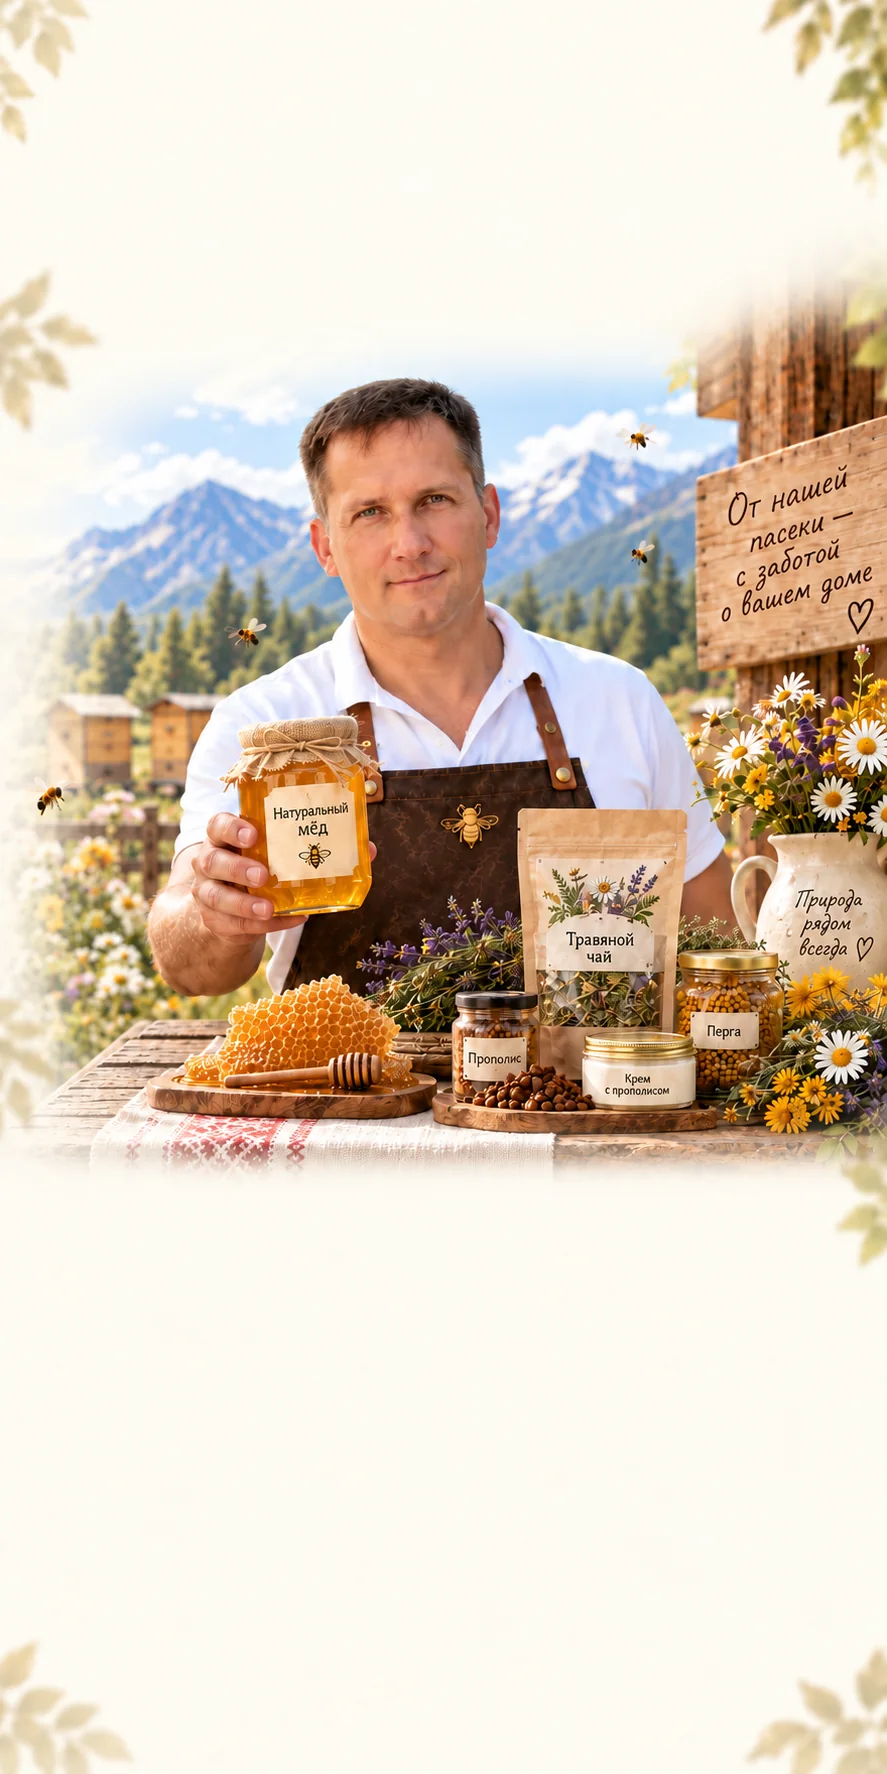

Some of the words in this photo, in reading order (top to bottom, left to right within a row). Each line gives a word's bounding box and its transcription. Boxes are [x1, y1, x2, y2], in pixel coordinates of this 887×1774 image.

[728, 492, 761, 525] От
[771, 464, 848, 512] нашей
[750, 516, 824, 552] пасеки
[736, 570, 746, 586] с
[755, 539, 840, 591] заботой
[721, 606, 731, 622] о
[742, 584, 810, 616] вашем
[821, 566, 873, 604] доме
[273, 802, 349, 821] Натуральный
[298, 821, 328, 836] мёд
[795, 889, 863, 914] Природа
[800, 913, 851, 938] рядом
[566, 931, 634, 950] Травяной
[800, 937, 847, 961] всегда
[587, 951, 612, 963] чай
[707, 1025, 741, 1040] Перга
[468, 1052, 522, 1067] Прополис
[625, 1073, 651, 1086] Крем
[612, 1087, 670, 1098] прополисом
